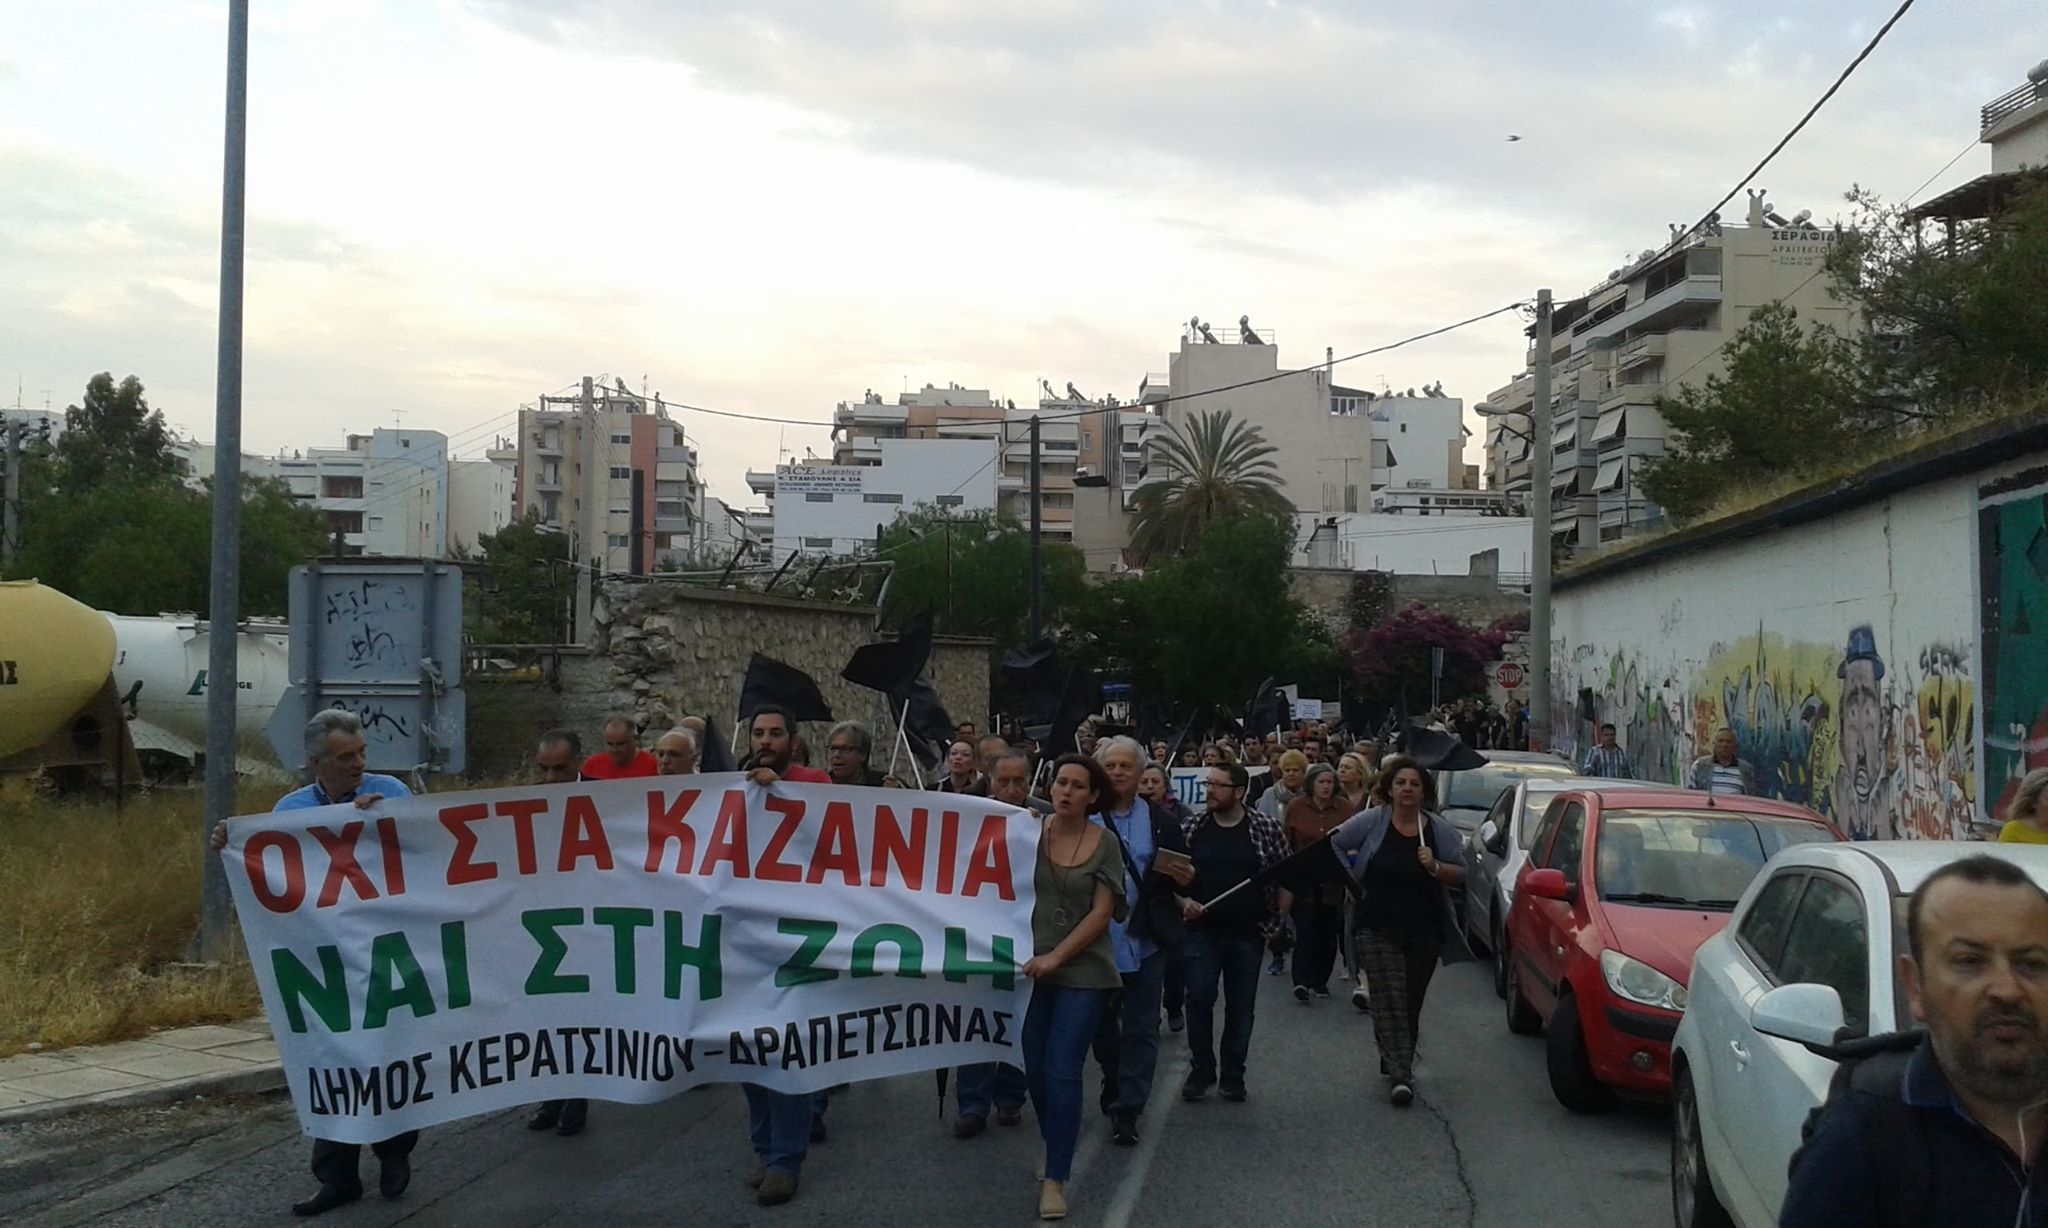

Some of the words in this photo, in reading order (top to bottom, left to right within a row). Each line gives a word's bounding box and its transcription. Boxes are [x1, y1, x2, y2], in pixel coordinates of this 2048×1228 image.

[1772, 231, 1835, 242] ΣΕΡΑΦΙΔ
[1498, 669, 1522, 683] STOP
[243, 817, 405, 914] ΟΧΙ
[438, 795, 614, 885] ΣΤΑ
[644, 790, 1016, 901] ΚΑΖΑΝΙΑ
[271, 920, 471, 1034] ΝΑΙ
[521, 907, 723, 1000] ΣΤΗ
[774, 917, 1015, 991] ΖΩΗ
[308, 1051, 434, 1117] ΔΗΜΟΣ
